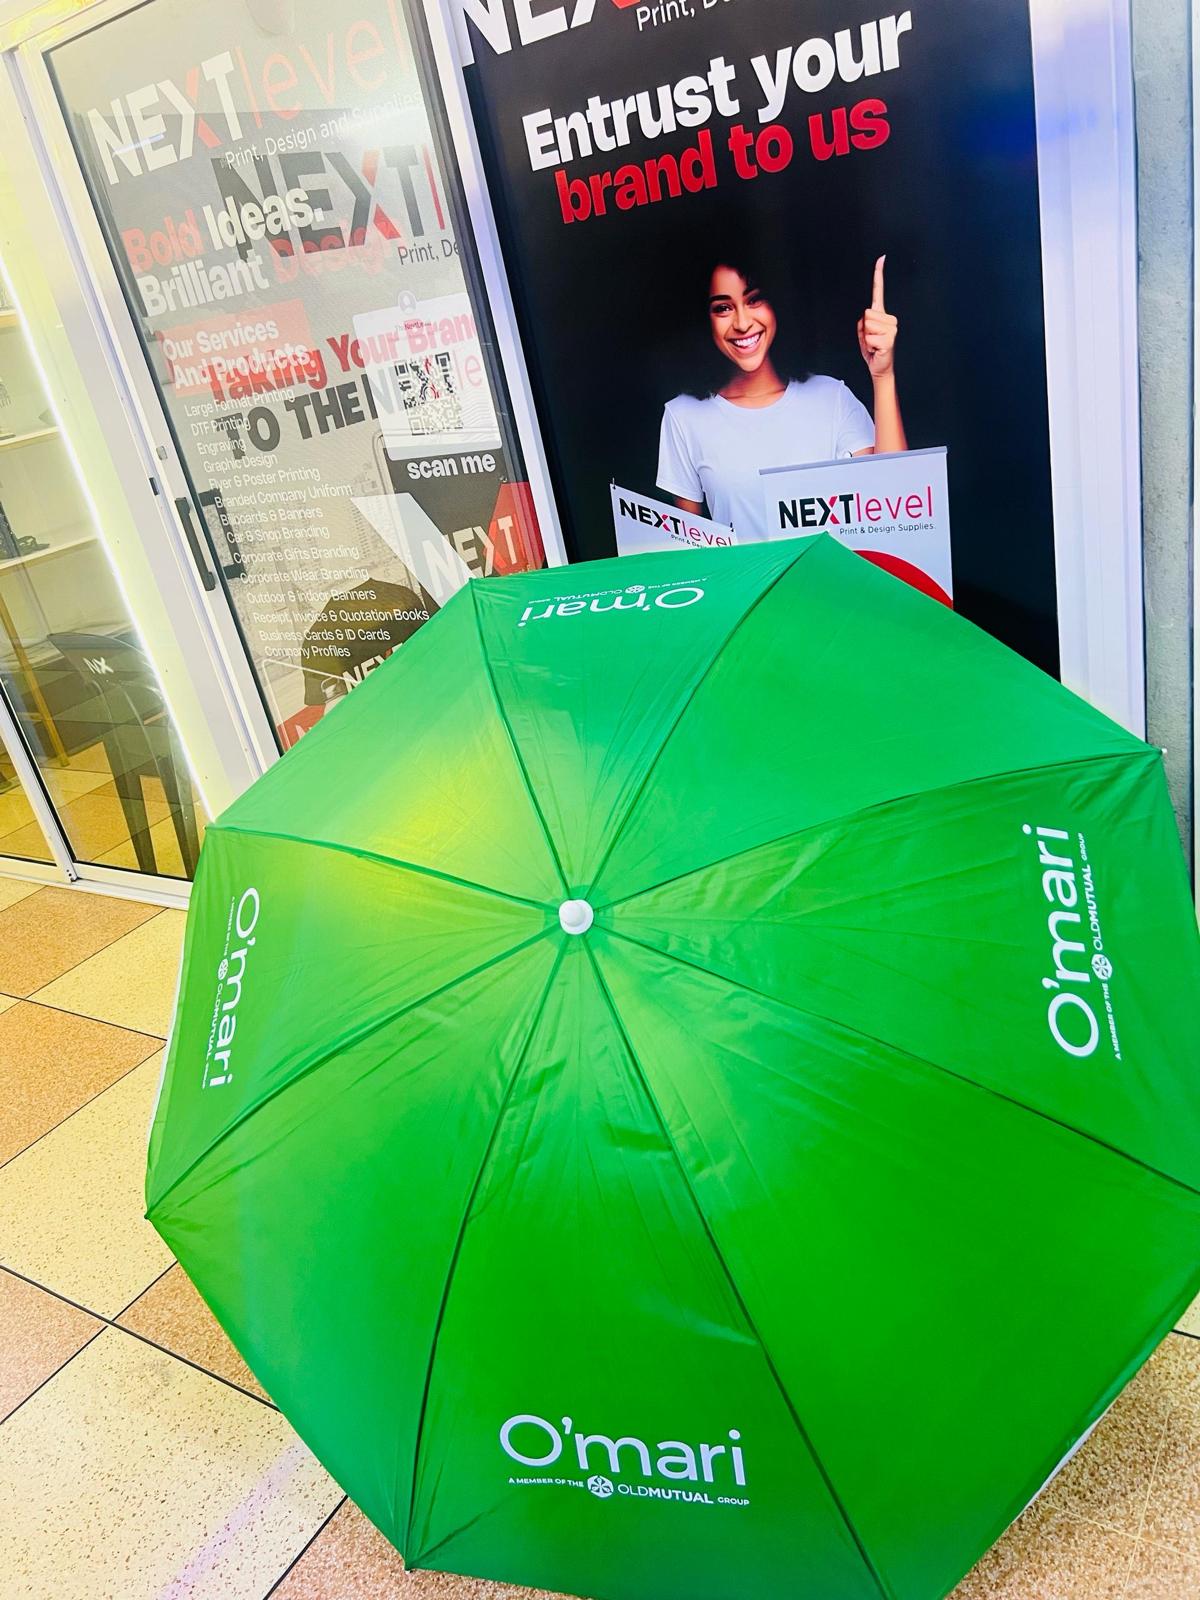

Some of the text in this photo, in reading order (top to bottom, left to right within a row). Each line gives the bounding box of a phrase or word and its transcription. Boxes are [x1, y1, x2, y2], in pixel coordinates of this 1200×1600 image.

[522, 10, 912, 172] Entrust your
[224, 141, 264, 170] Print,
[264, 126, 317, 157] Design
[320, 112, 350, 138] and
[554, 98, 891, 224] brand to us
[122, 187, 325, 274] Bold Ideas.
[398, 239, 440, 265] Print,
[136, 249, 270, 317] Brilliant
[162, 320, 279, 361] Our Services
[326, 332, 400, 373] Your
[404, 313, 476, 353] Bran
[173, 356, 212, 389] And
[184, 388, 295, 417] Large Format Printing
[190, 415, 251, 436] DTF Printing
[213, 405, 281, 461] TO
[284, 380, 366, 440] THE
[196, 437, 247, 456] Engraving
[203, 453, 279, 474] Graphic Design
[243, 471, 276, 486] Poster
[277, 466, 321, 483] Printing
[407, 453, 496, 480] scan me
[214, 483, 353, 509] Branded Company Uniform
[778, 485, 933, 529] NEXTlevel
[278, 506, 324, 520] Banners
[254, 528, 282, 544] Shop
[282, 525, 330, 541] Branding
[839, 526, 858, 535] Print
[860, 526, 867, 534] &
[868, 524, 896, 535] Design
[233, 550, 284, 564] Corporate
[311, 544, 360, 560] Branding
[239, 566, 369, 584] Corporate Wear Branding
[247, 591, 286, 604] Outdoor
[331, 588, 377, 601] Banners
[517, 587, 705, 627] O'mari
[329, 610, 338, 622] &
[339, 609, 393, 623] Quotation
[393, 608, 430, 621] Books
[259, 628, 391, 642] Business Cards & ID Cards
[264, 644, 351, 659] Company Profiles
[1078, 832, 1088, 861] GROUP
[1022, 824, 1099, 1058] O'mari
[209, 887, 260, 1087] O'mari
[1101, 983, 1110, 1000] THE
[1104, 1000, 1113, 1013] OF
[1107, 1014, 1120, 1052] MEMBER
[499, 1413, 746, 1486] O'mari
[516, 1477, 553, 1485] MEMBER
[554, 1478, 567, 1486] OF
[567, 1479, 585, 1488] THE
[717, 1496, 750, 1507] GROUP
